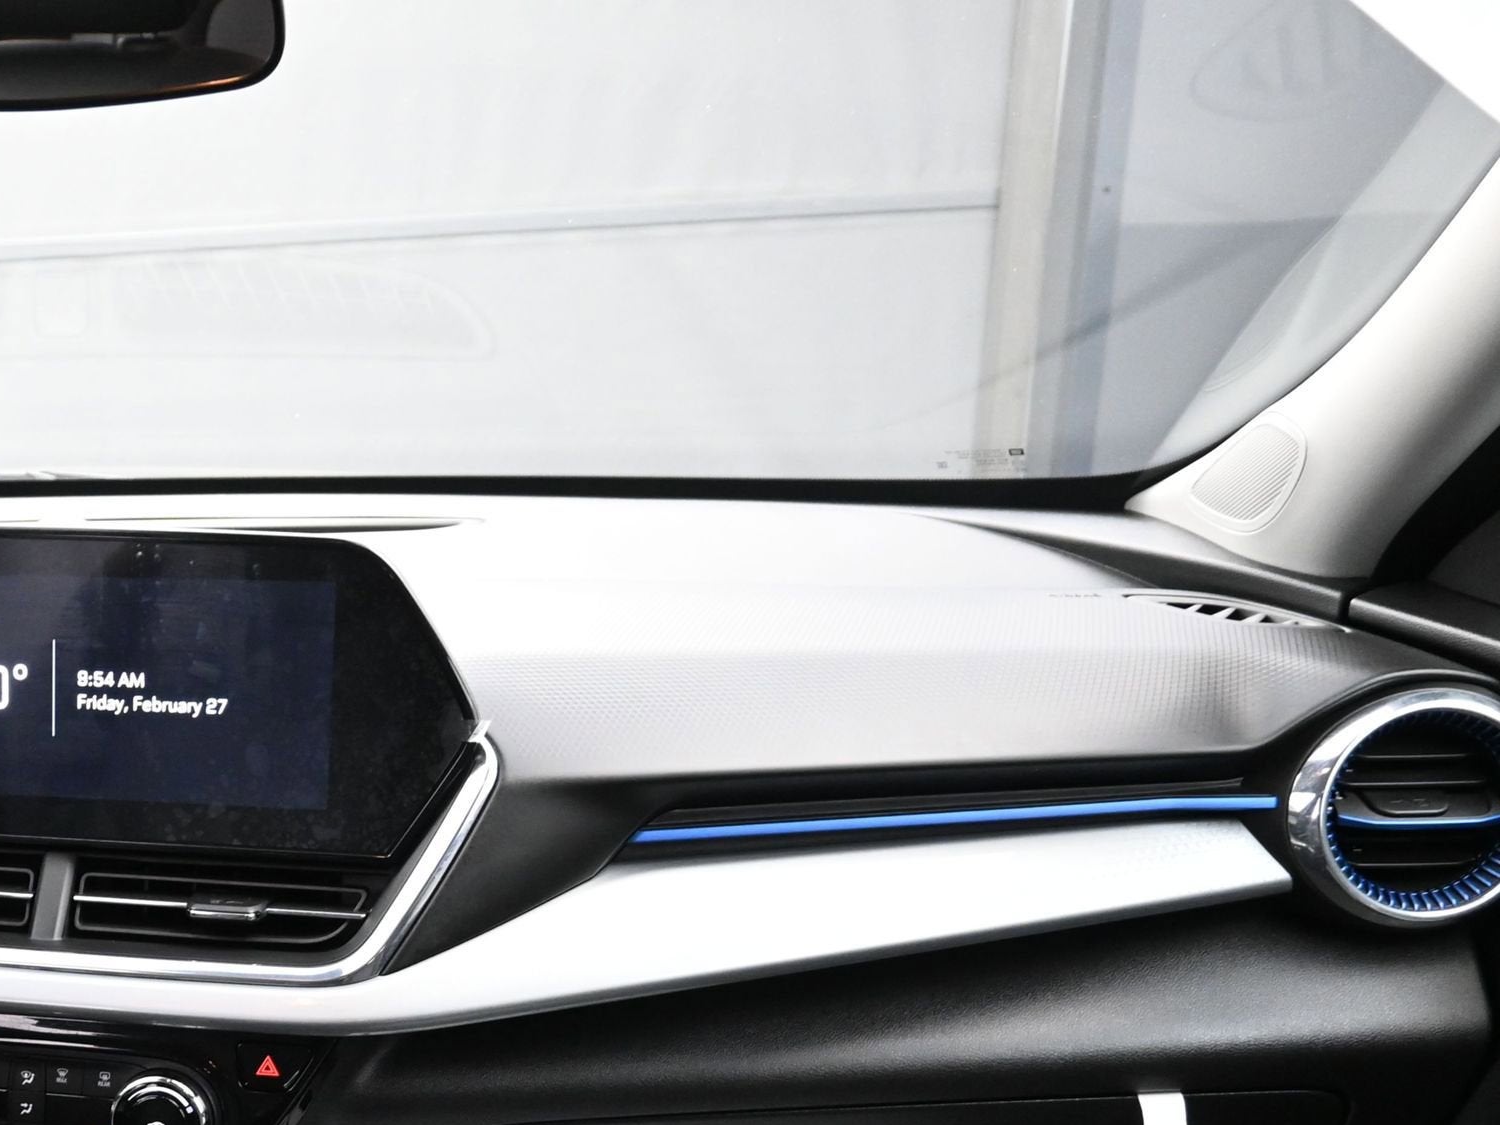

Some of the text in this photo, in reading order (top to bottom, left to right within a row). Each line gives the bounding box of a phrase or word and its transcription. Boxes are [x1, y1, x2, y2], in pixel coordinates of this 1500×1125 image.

[76, 669, 145, 689] 9:54 AM
[76, 693, 229, 718] Friday, February 27
